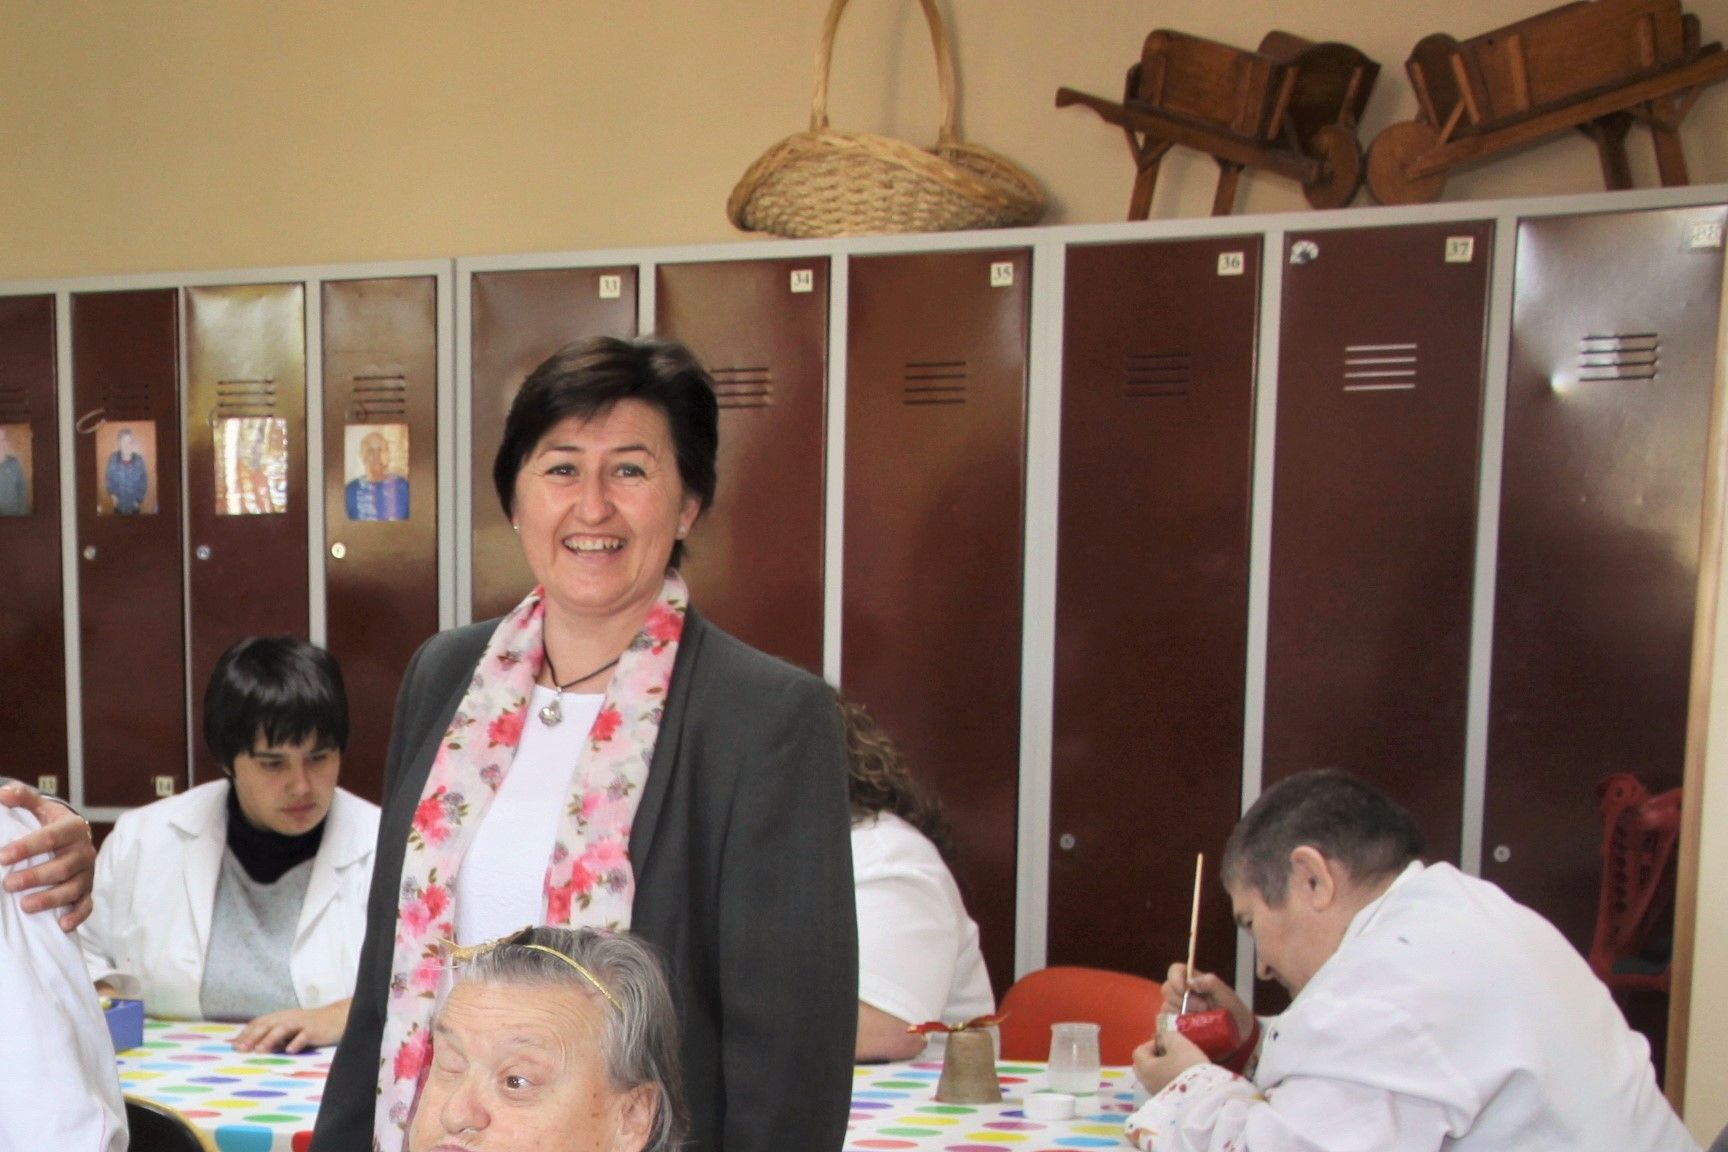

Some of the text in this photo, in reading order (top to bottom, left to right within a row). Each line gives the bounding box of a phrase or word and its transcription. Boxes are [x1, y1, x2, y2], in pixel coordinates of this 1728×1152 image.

[1450, 240, 1469, 257] 37
[1221, 255, 1240, 270] 36
[993, 265, 1011, 280] 35
